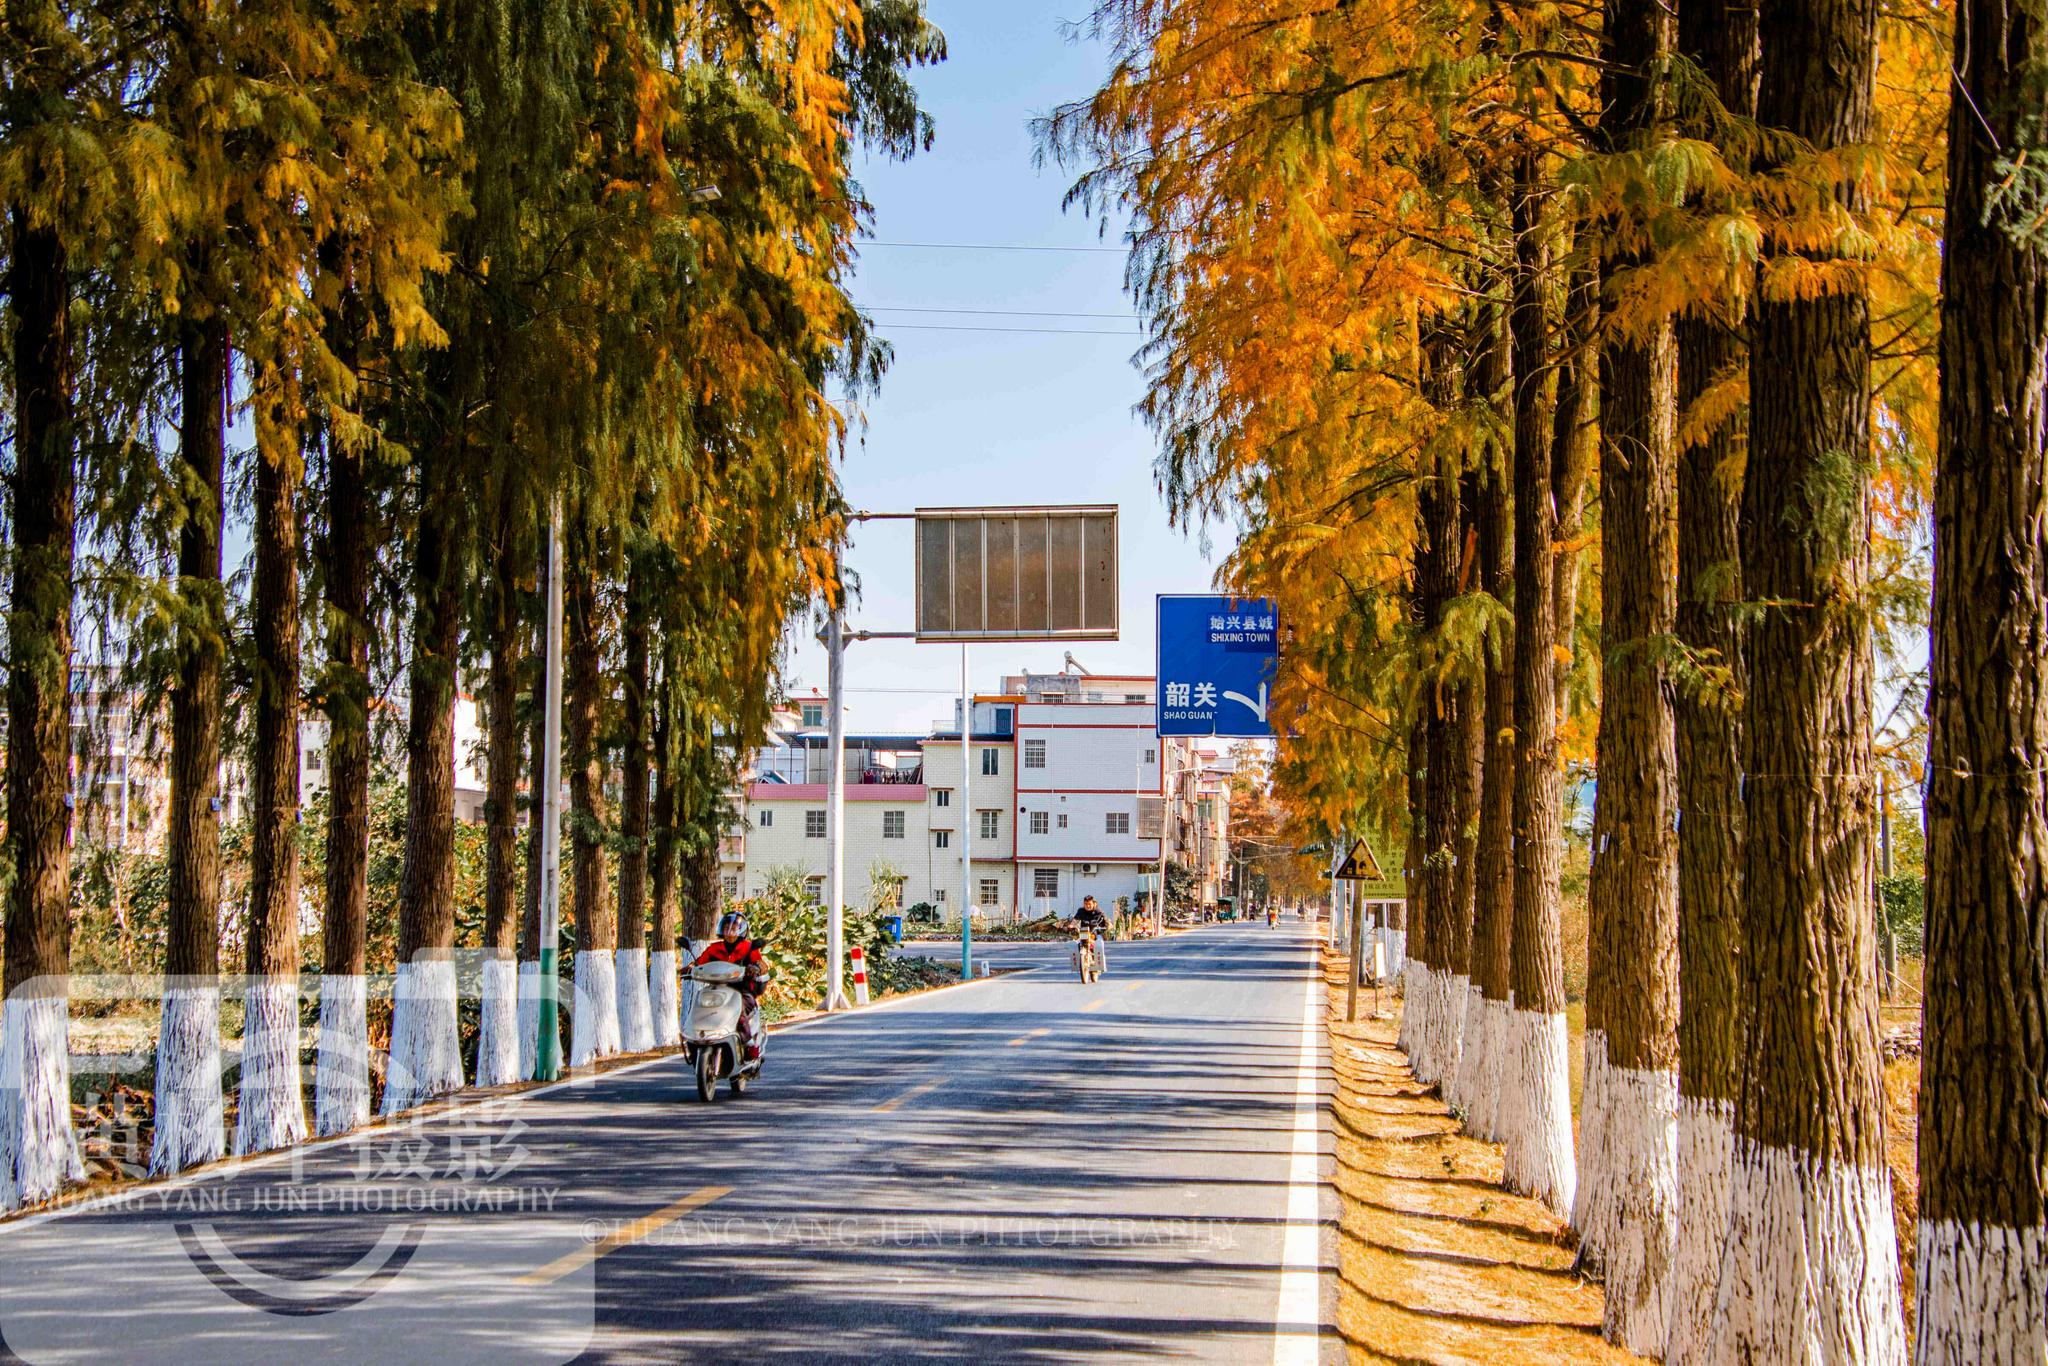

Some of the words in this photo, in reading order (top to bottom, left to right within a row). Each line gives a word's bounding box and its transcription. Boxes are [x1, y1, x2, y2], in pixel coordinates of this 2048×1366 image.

[1210, 615, 1273, 630] 始兴县城
[1211, 633, 1243, 643] SHIXING
[1245, 633, 1270, 642] TOWN
[1165, 682, 1217, 708] 韶关
[1163, 711, 1186, 720] SHAO
[1188, 711, 1213, 720] GUAN
